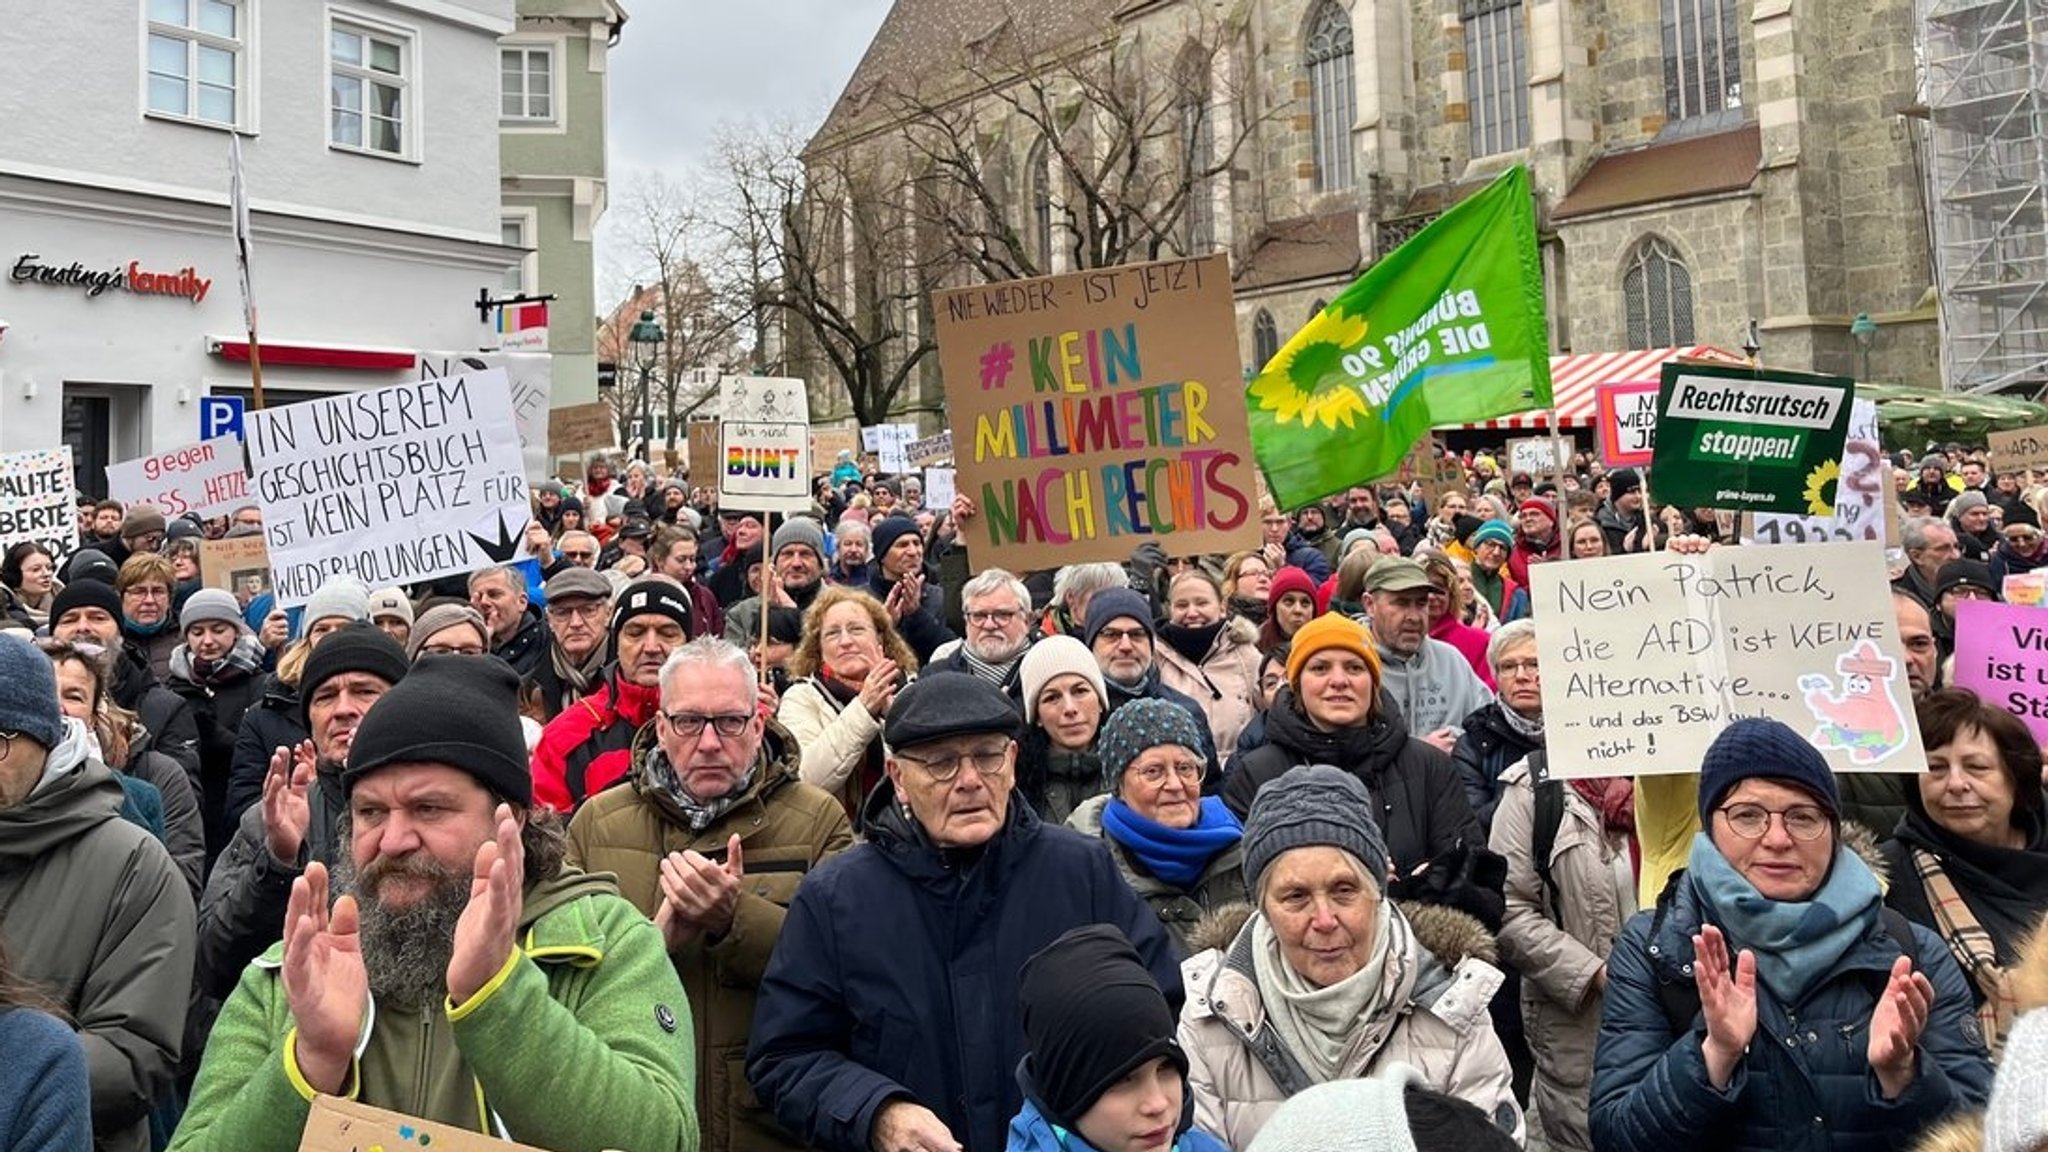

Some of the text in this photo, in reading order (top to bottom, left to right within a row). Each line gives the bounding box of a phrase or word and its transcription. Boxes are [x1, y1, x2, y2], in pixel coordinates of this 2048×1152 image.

[12, 254, 211, 302] Ernsting's family
[948, 293, 979, 322] NIE
[985, 281, 1058, 316] WIEDER
[1082, 273, 1120, 304] IST
[1126, 257, 1214, 310] JETZT
[1028, 322, 1142, 393] KEIN
[210, 402, 234, 438] P
[254, 377, 473, 457] IN UNSEREM
[1678, 383, 1831, 421] Rechtsrutsch
[760, 422, 789, 438] sind
[974, 380, 1218, 464] MILLIMETER
[143, 443, 216, 481] gegen
[726, 445, 800, 480] BUNT
[1698, 428, 1801, 462] stoppen!
[0, 461, 65, 498] ALITÉ
[258, 428, 489, 504] GESCHICHTSBUCH
[204, 471, 250, 506] HETZE
[981, 448, 1250, 547] NACH RECHTS
[267, 470, 526, 547] IST KEIN PLATZ FÜR
[273, 529, 469, 600] WIEDERHOLUNGEN
[1557, 562, 1835, 614] Nein Patrick,
[1562, 617, 1885, 662] die AfD ist KEINE
[1565, 670, 1791, 701] Alternative...
[1987, 656, 2026, 683] ist
[1589, 708, 1623, 729] und
[1632, 711, 1664, 728] das
[1669, 702, 1721, 722] BSW
[1586, 735, 1637, 761] nicht
